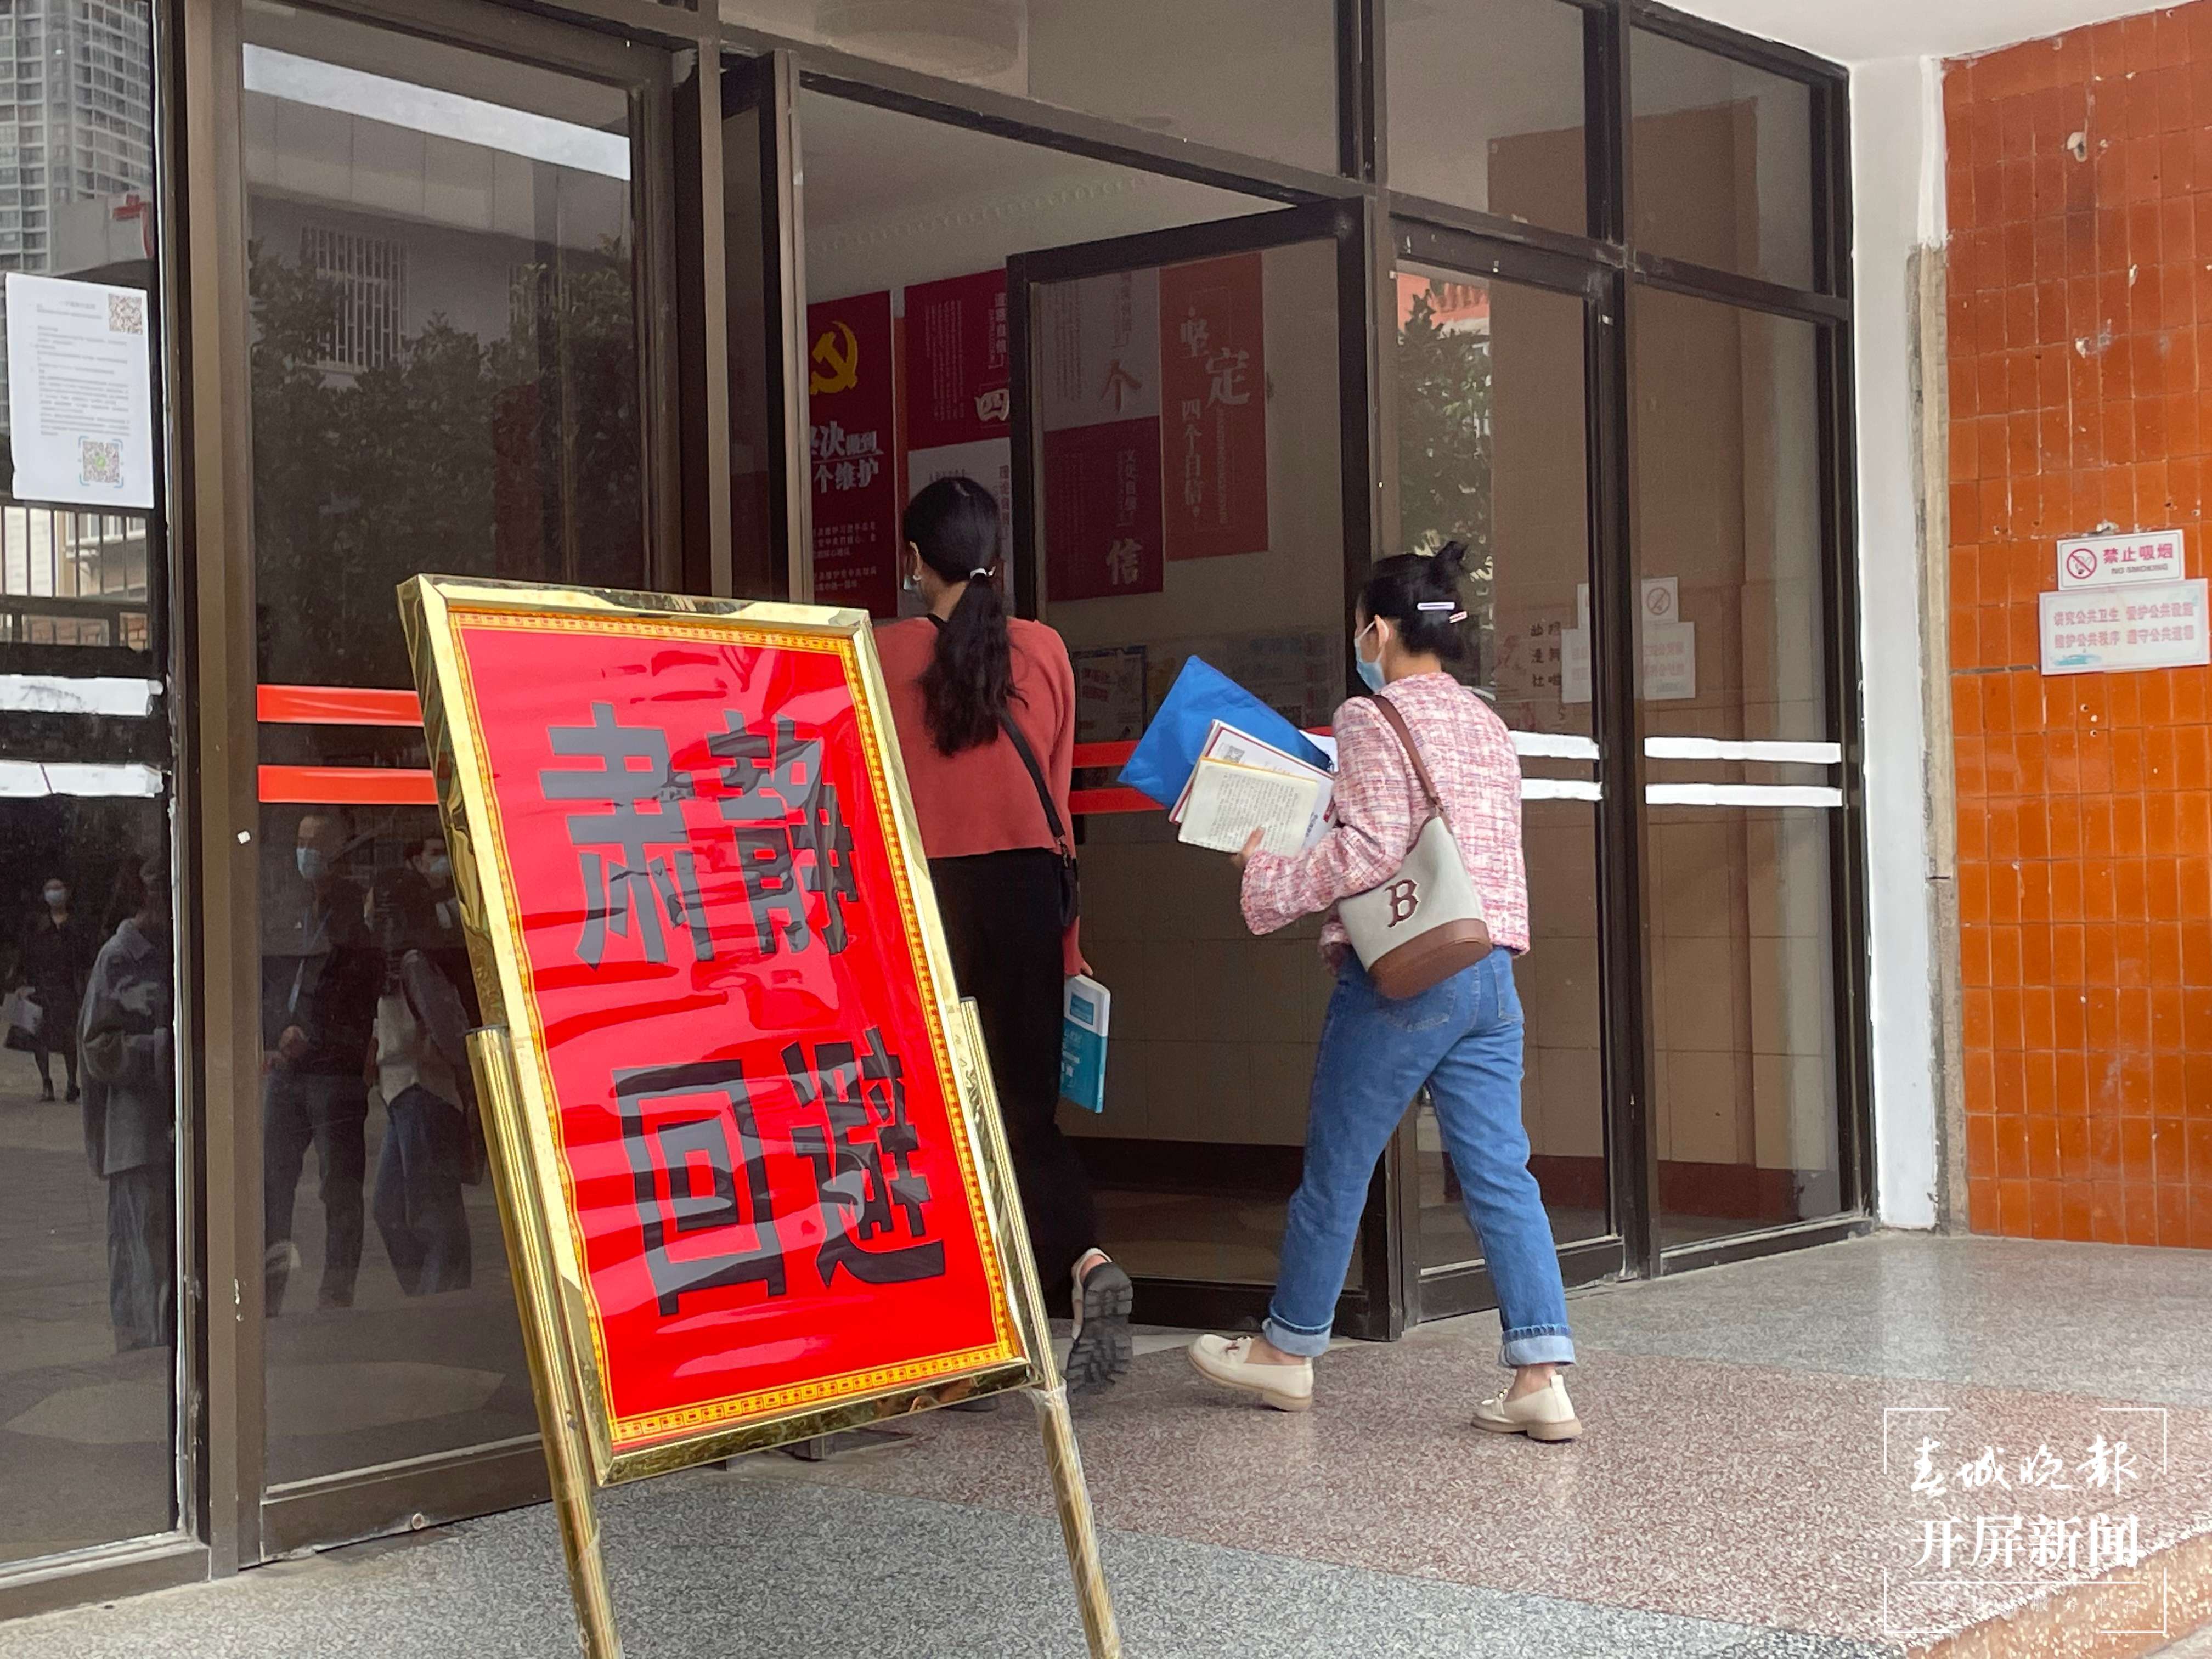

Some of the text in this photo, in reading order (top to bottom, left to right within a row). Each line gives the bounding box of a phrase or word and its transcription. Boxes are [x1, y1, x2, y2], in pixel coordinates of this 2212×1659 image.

[975, 387, 1010, 422] 四
[1099, 359, 1142, 413] 个
[813, 455, 879, 494] 个维护
[1106, 538, 1143, 585] 信
[2103, 543, 2174, 564] 禁止吸烟
[2126, 563, 2168, 573] SMOKING
[2126, 602, 2194, 621] 爱护公共设施
[540, 702, 858, 969] 肃静
[1384, 879, 1421, 927] B
[611, 1026, 945, 1316] 回避
